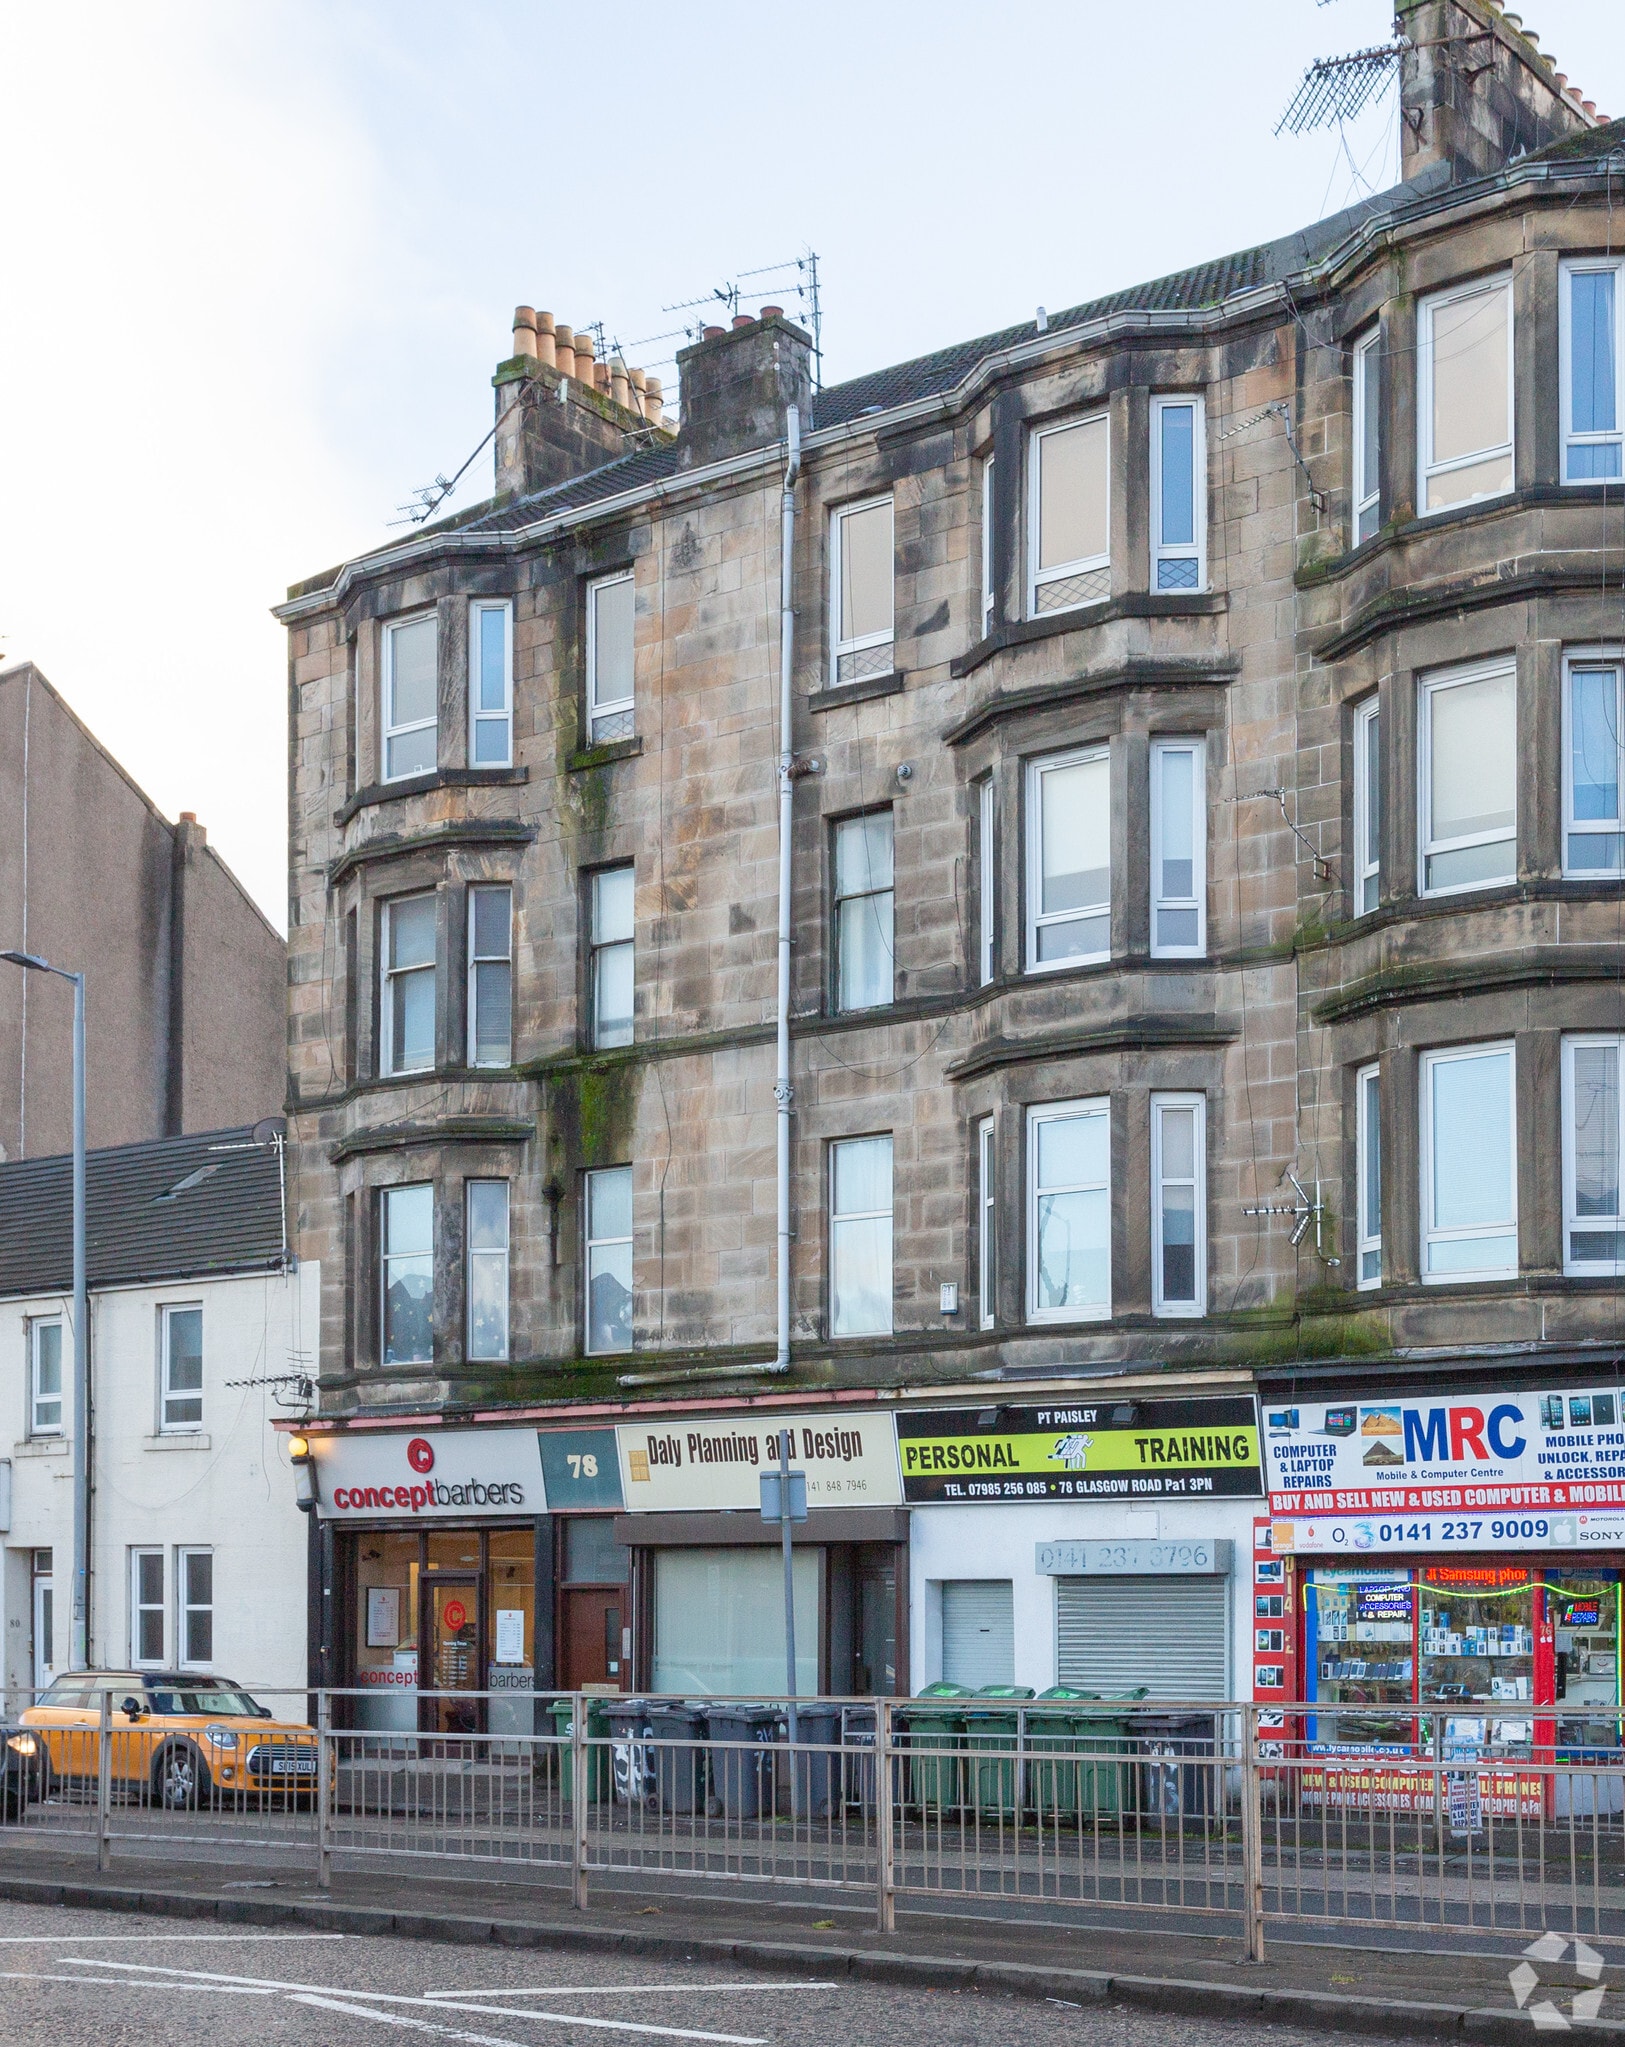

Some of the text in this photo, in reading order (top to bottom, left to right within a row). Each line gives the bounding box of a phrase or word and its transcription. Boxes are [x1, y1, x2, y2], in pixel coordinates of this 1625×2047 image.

[1037, 1410, 1097, 1424] PT PAISLEY
[1403, 1403, 1526, 1462] MRC
[646, 1434, 682, 1468] Daly
[687, 1431, 759, 1466] Planning
[802, 1428, 864, 1462] Design
[1545, 1434, 1594, 1448] MOBILE
[905, 1434, 1250, 1470] PERSONAL TRAINING
[1273, 1444, 1337, 1459] COMPUTER
[1538, 1451, 1592, 1465] UNLOCK,
[567, 1454, 598, 1479] 78
[1280, 1459, 1334, 1473] & LAPTOP
[1376, 1468, 1504, 1481] Mobile & Computer Centre
[1544, 1471, 1553, 1480] &
[826, 1480, 841, 1491] 848
[846, 1479, 867, 1491] 7946
[944, 1477, 1213, 1496] TEL. 07985 256 085 78 GLASGOW ROAD Pa1 3PN
[1283, 1475, 1332, 1489] REPAIRS
[1272, 1494, 1301, 1511] BUY
[1304, 1492, 1334, 1510] AND
[1336, 1491, 1369, 1509] SELL
[1372, 1490, 1405, 1508] NEW
[1408, 1492, 1420, 1507] &
[1422, 1489, 1461, 1507] USED
[1464, 1486, 1550, 1506] COMPUTER
[1553, 1488, 1566, 1503] &
[1379, 1519, 1549, 1542] 0141 237 9009
[1579, 1531, 1624, 1541] SONY
[1299, 1540, 1324, 1548] vodafone
[1439, 1567, 1496, 1584] Samsung
[1365, 1593, 1404, 1602] COMPUTER
[1359, 1601, 1412, 1611] ACCESSORIES
[10, 1619, 21, 1628] 80
[1540, 1625, 1552, 1635] 76
[361, 1670, 418, 1687] concept
[1329, 1776, 1337, 1788] &
[1340, 1776, 1370, 1789] USED
[1521, 1801, 1529, 1814] &
